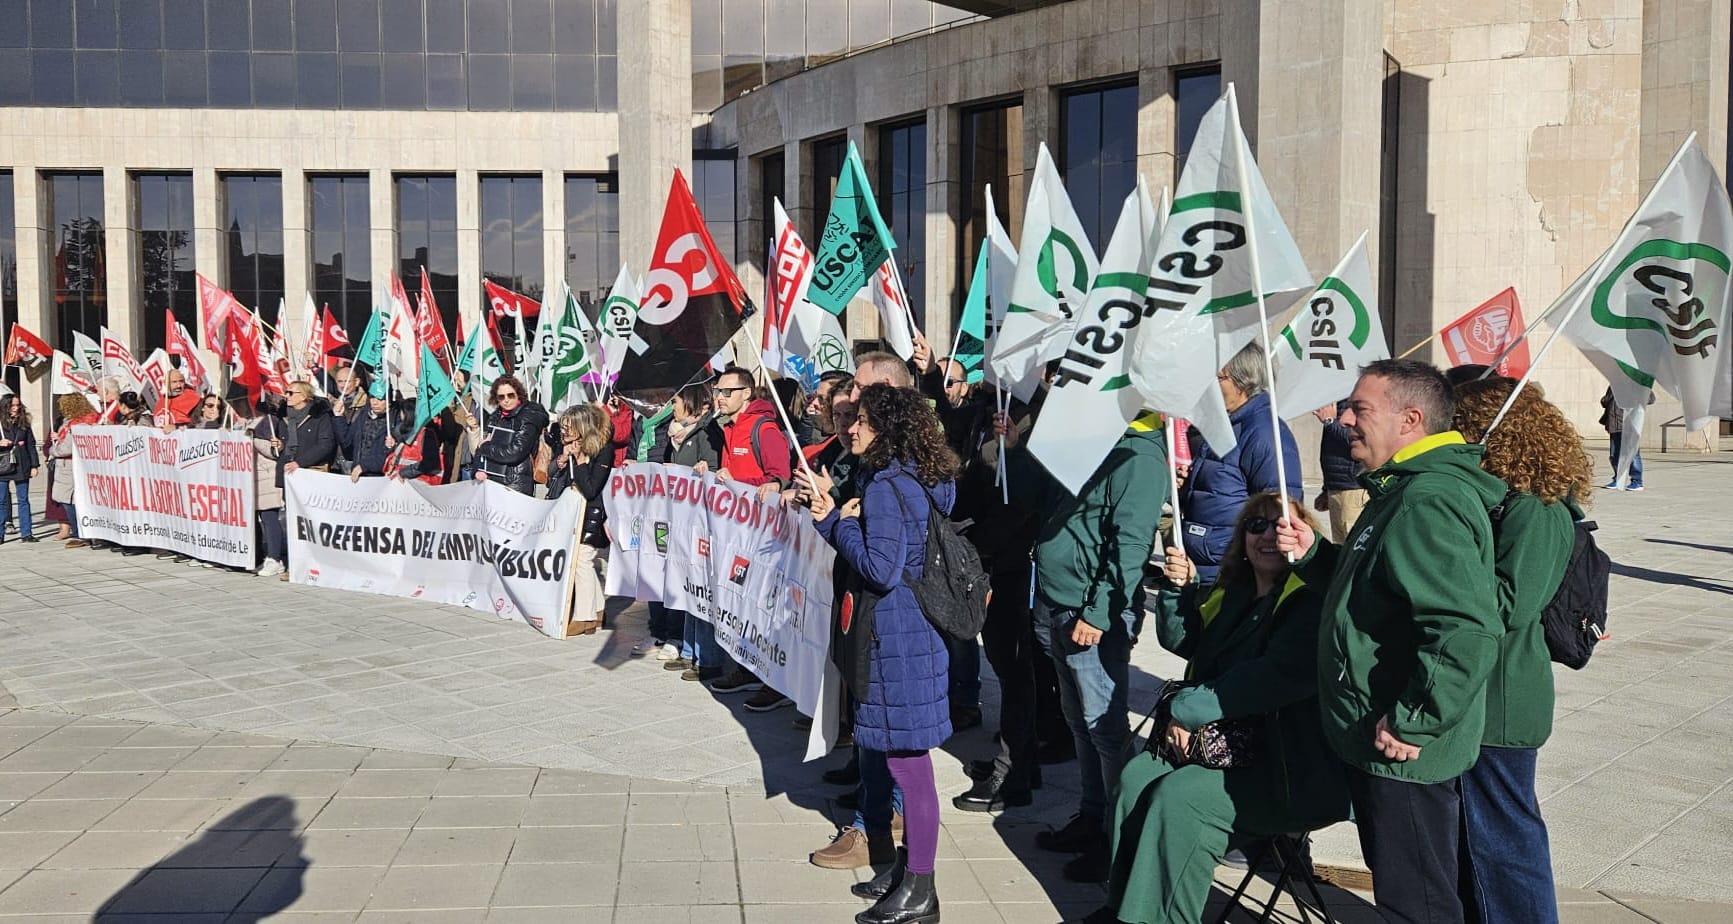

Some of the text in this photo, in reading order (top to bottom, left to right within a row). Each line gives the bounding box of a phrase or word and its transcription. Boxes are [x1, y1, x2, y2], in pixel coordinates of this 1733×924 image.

[1633, 265, 1718, 359] CSIF
[1310, 297, 1346, 370] CSIF
[105, 340, 144, 380] CCOO
[179, 440, 219, 463] nuestros
[188, 483, 248, 527] ESECIAL
[303, 493, 342, 512] JUNTA
[610, 474, 646, 497] POR
[667, 475, 762, 528] EDUACIÓN
[132, 523, 142, 535] de
[297, 515, 317, 544] EN
[319, 522, 407, 555] DEFENSA
[412, 529, 434, 559] DEL
[683, 577, 713, 602] Junta
